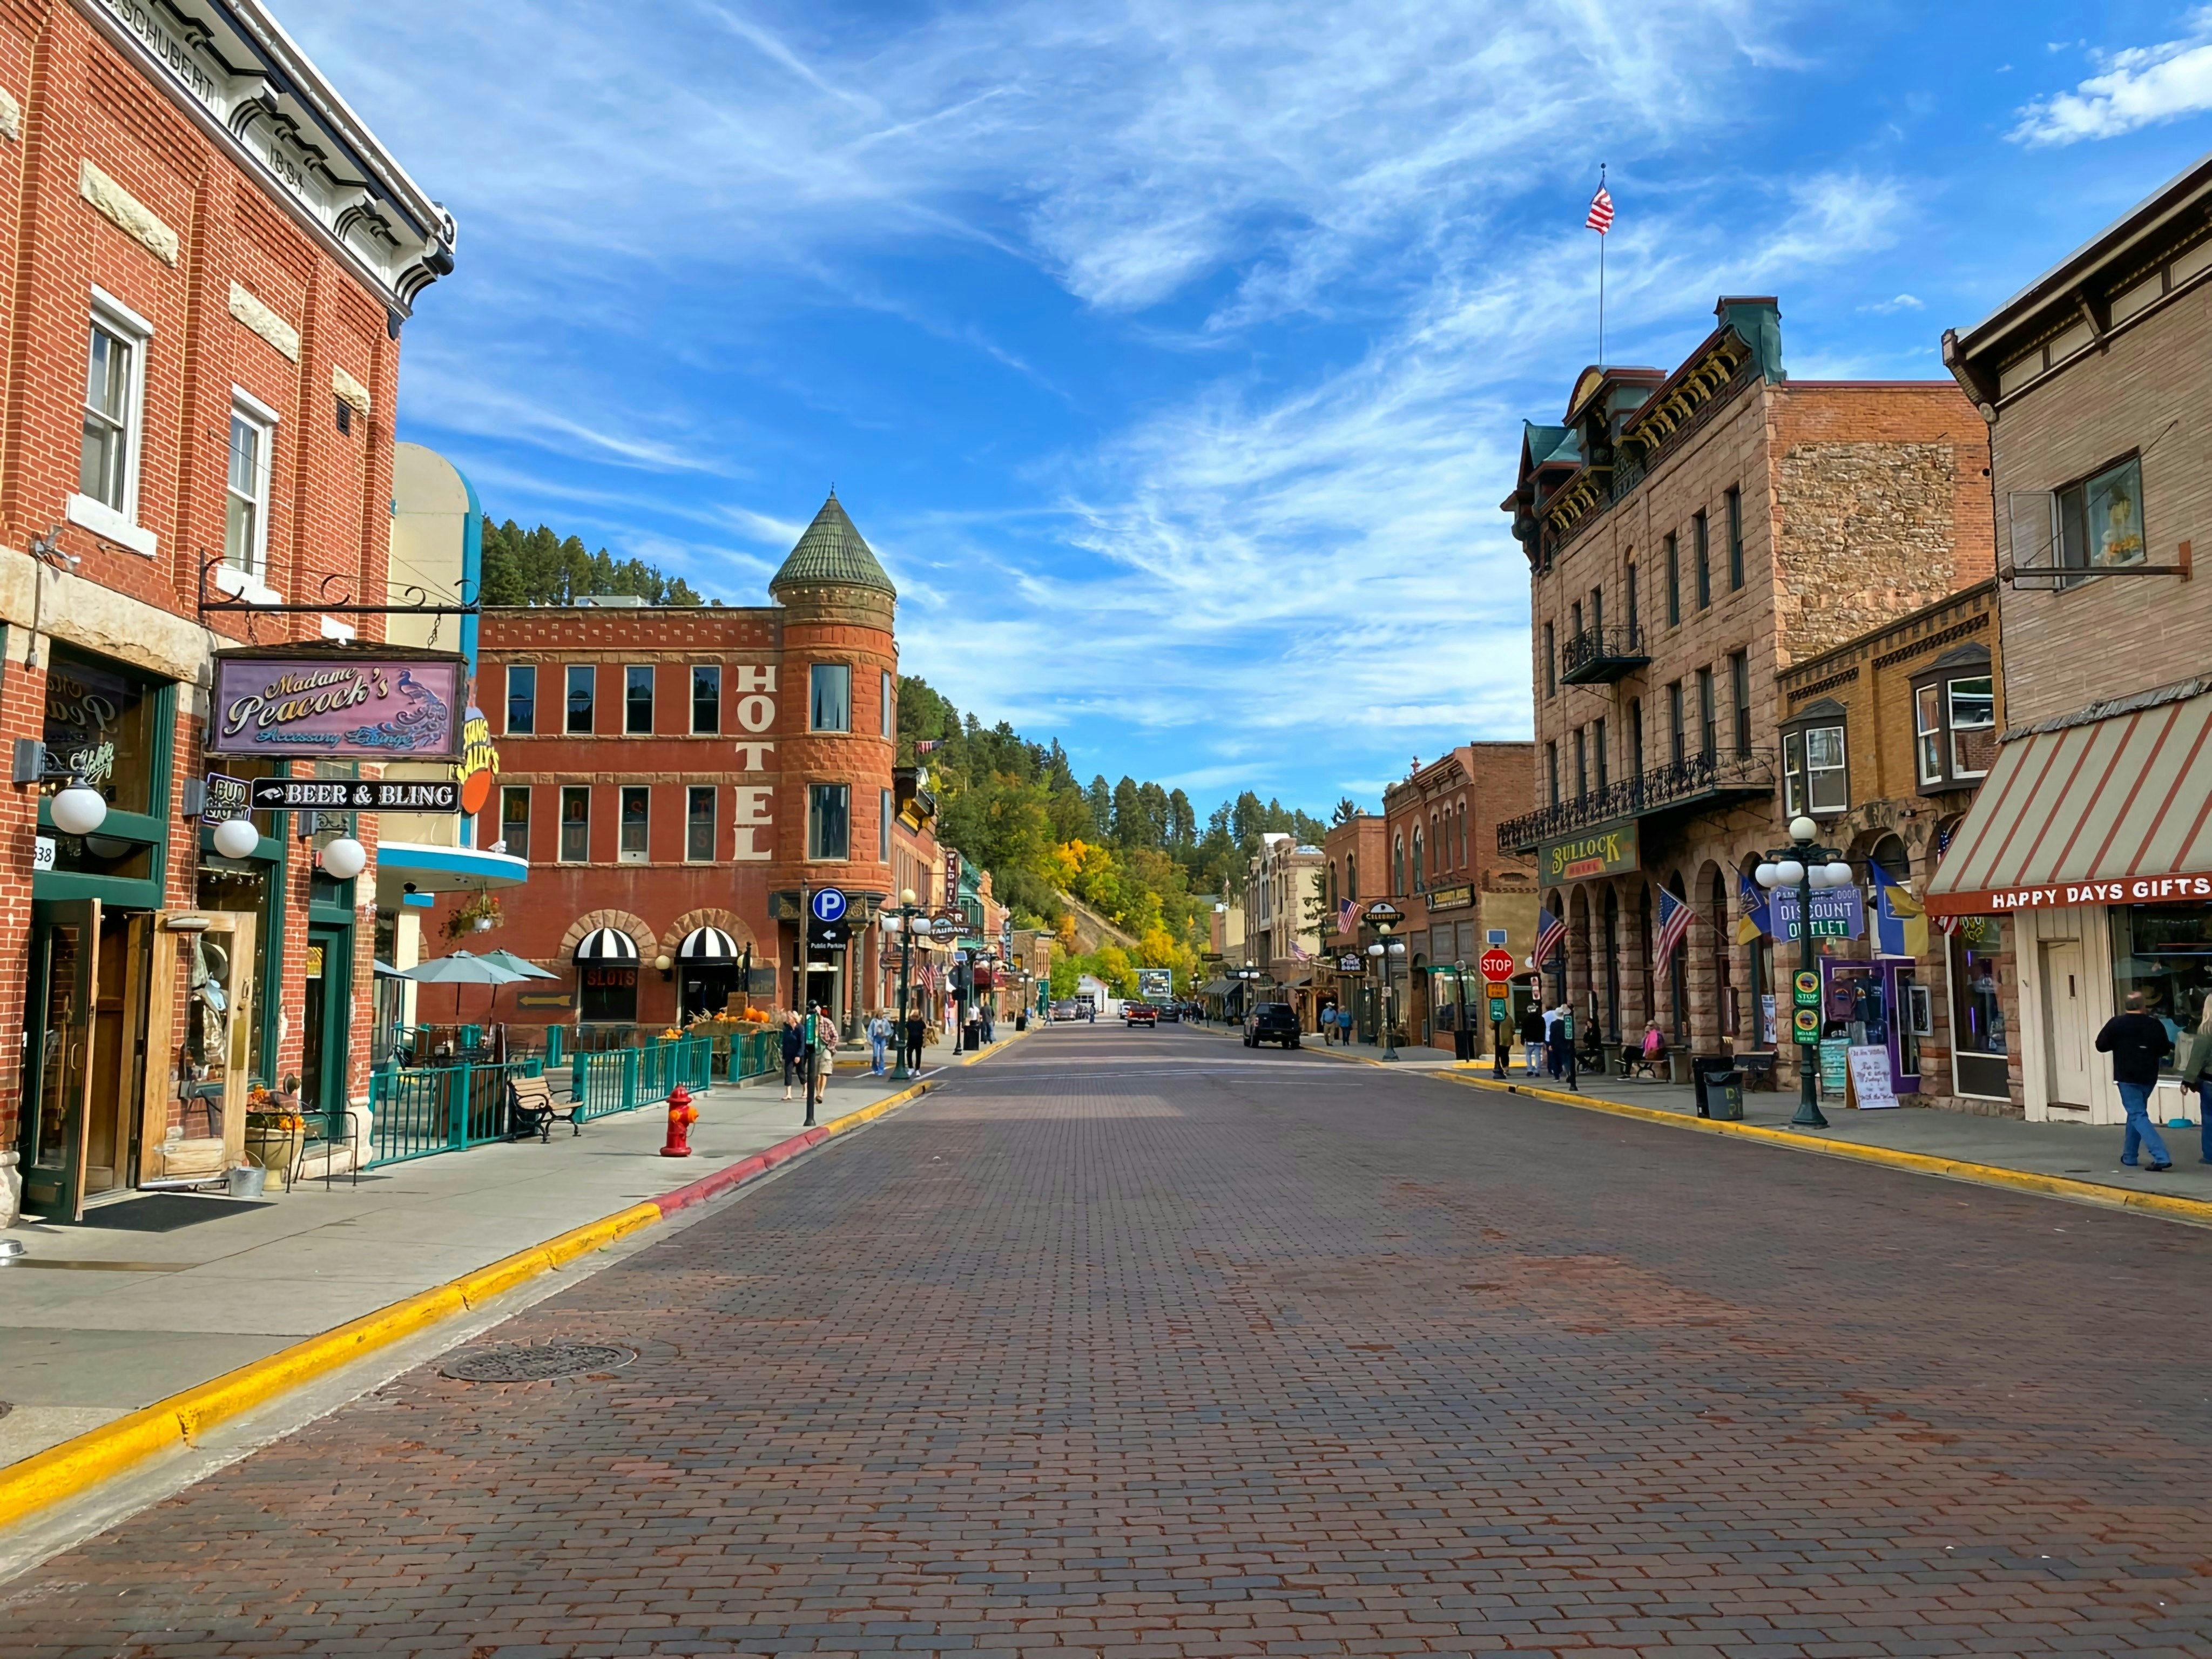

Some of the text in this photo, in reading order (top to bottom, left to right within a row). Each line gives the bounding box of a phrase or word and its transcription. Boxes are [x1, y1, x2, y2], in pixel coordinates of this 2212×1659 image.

[269, 143, 304, 194] 1894
[265, 667, 359, 700] Madame
[222, 667, 389, 737] Peacock's
[256, 726, 413, 748] Accessory Lounge
[733, 665, 777, 860] HOTEL
[215, 779, 246, 802] BUD
[285, 784, 453, 806] BEER & BLING
[206, 800, 249, 820] LIGT
[1552, 833, 1620, 874] BULLOCK
[821, 893, 840, 918] P
[1993, 878, 2211, 908] HAPPY DAYS GIFTS
[588, 970, 636, 986] SLOTS
[1483, 959, 1512, 972] STOP
